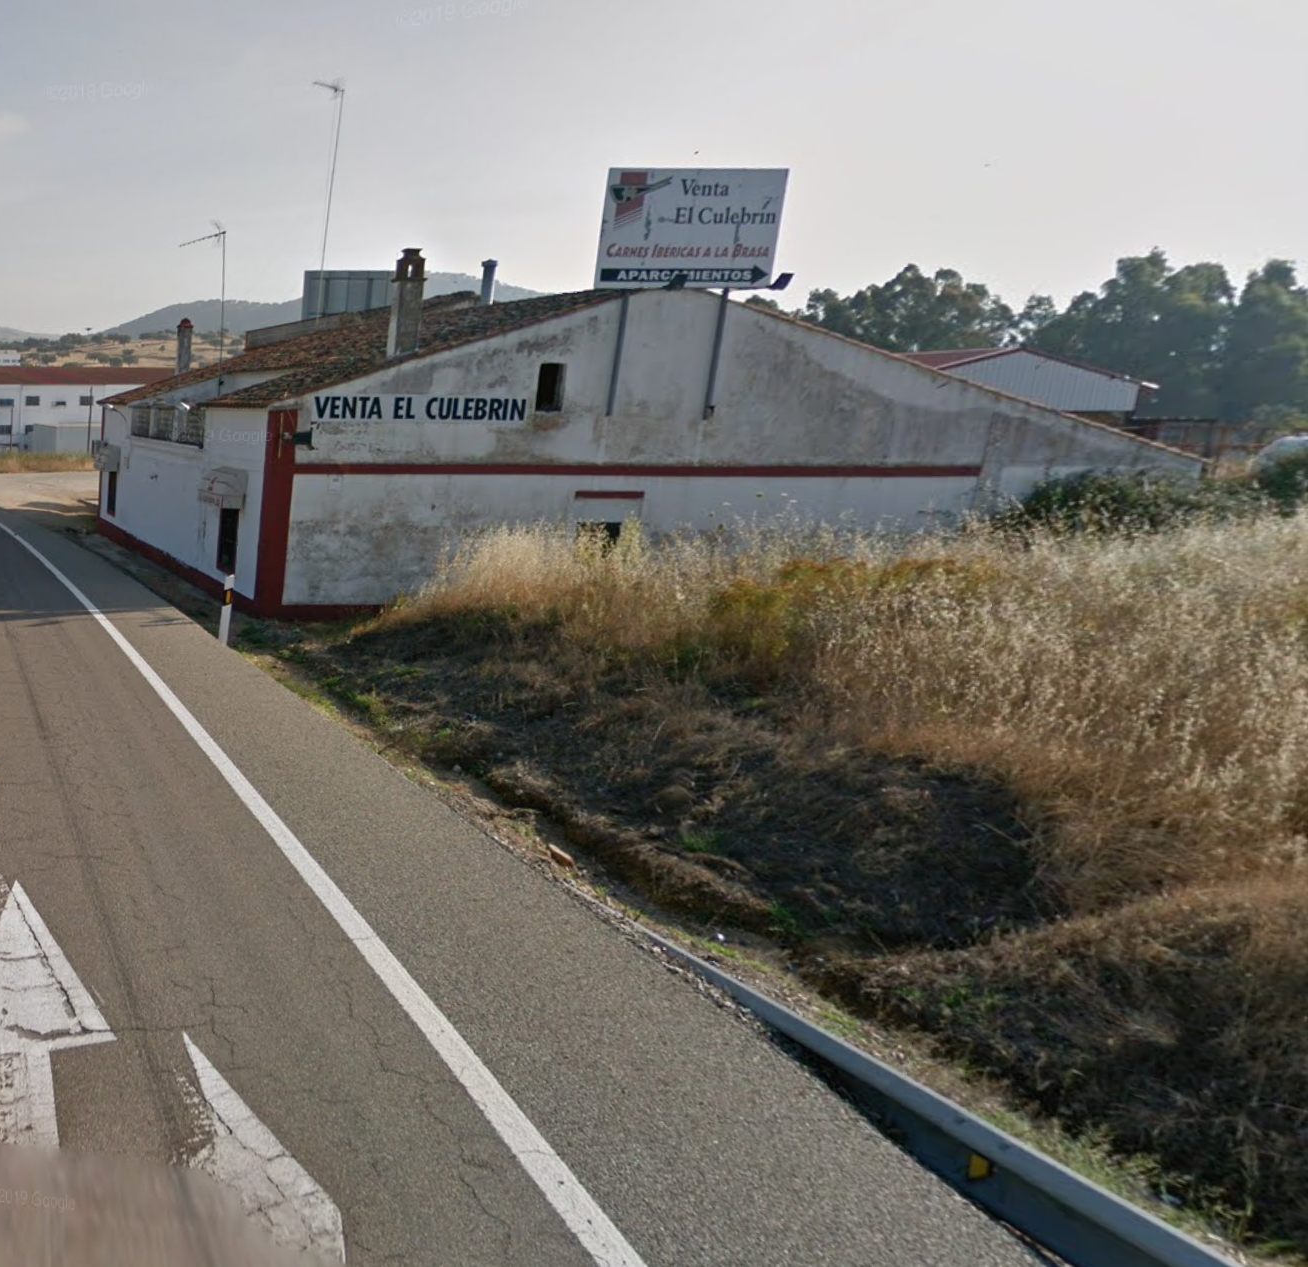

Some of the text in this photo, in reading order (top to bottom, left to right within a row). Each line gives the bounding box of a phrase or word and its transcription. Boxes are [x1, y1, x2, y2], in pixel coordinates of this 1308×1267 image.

[681, 178, 729, 197] Venta
[674, 206, 693, 225] El
[703, 246, 712, 258] A
[715, 246, 728, 258] LA
[314, 396, 526, 421] VENTA EL CULEBRIN
